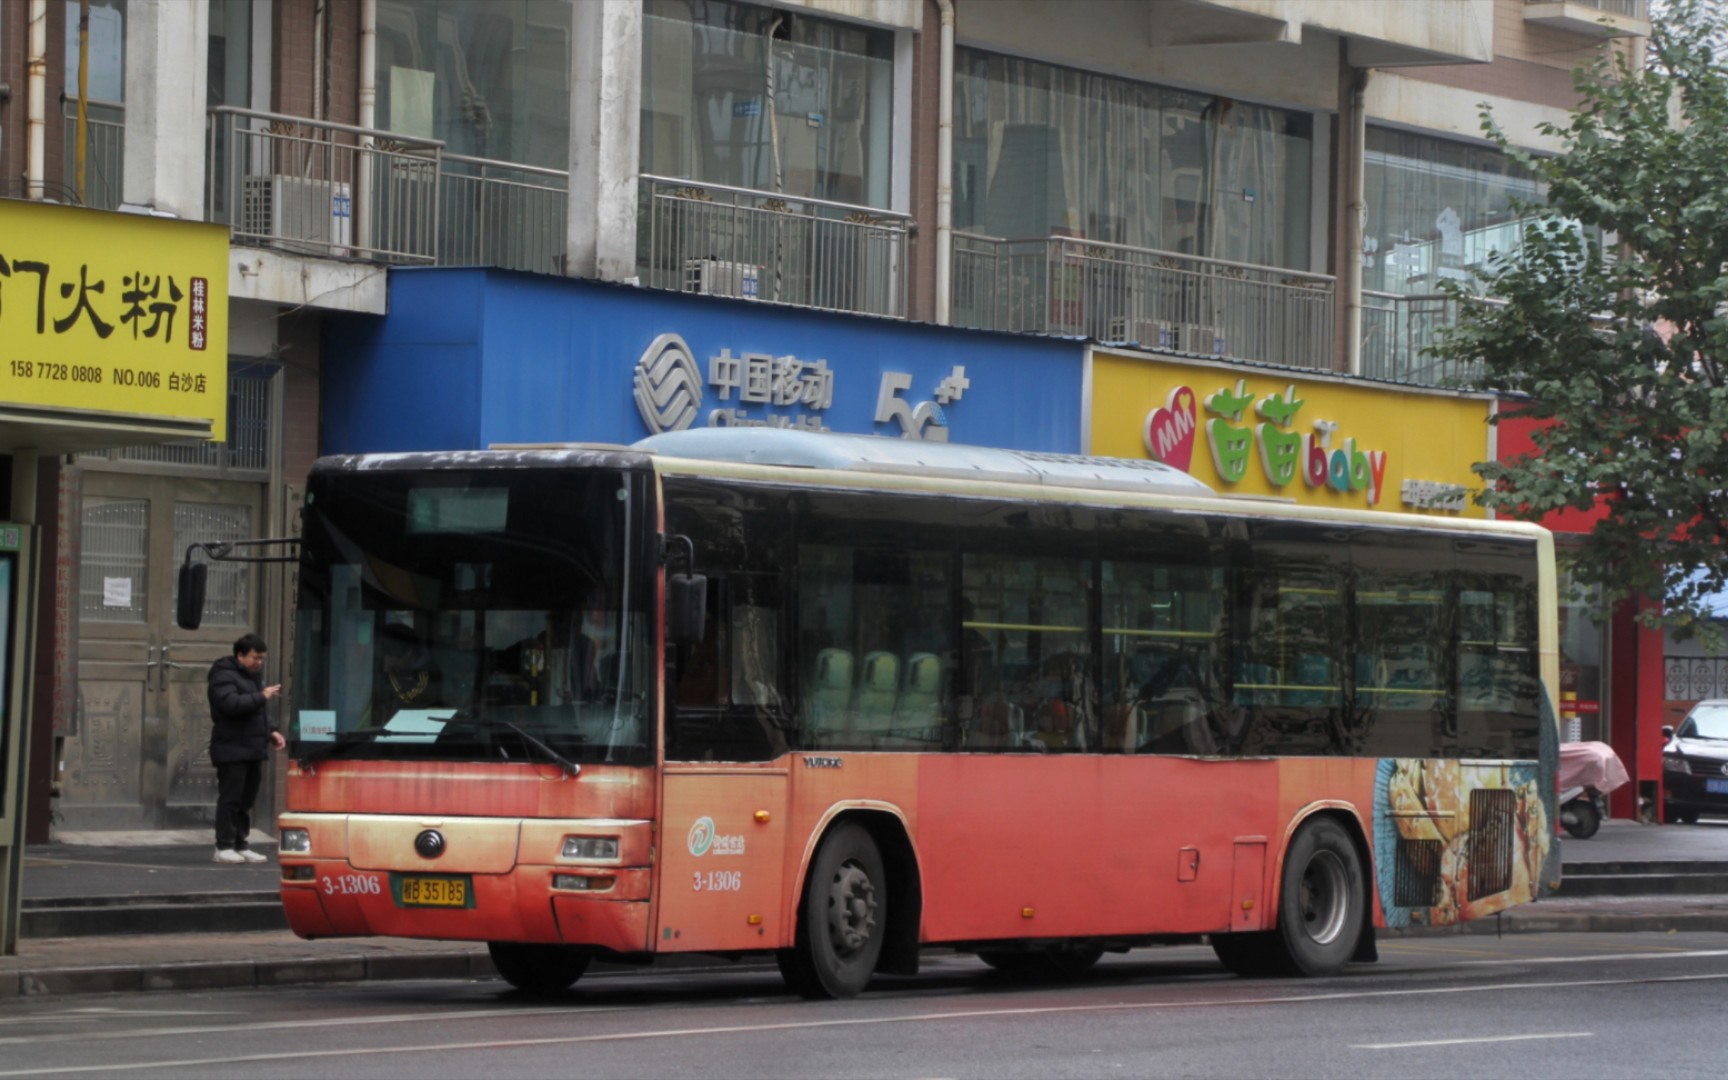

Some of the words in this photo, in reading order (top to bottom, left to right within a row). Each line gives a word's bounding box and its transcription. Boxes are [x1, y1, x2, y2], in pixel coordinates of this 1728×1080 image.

[191, 279, 206, 348] 桂林米粉
[10, 360, 33, 378] 158
[37, 362, 68, 381] 7728
[71, 364, 102, 384] 0808
[113, 368, 161, 388] NO.006
[168, 371, 207, 394] 白沙店
[708, 347, 834, 410] 中国移动
[322, 874, 381, 895] 3-1306
[693, 870, 742, 892] 3-1306
